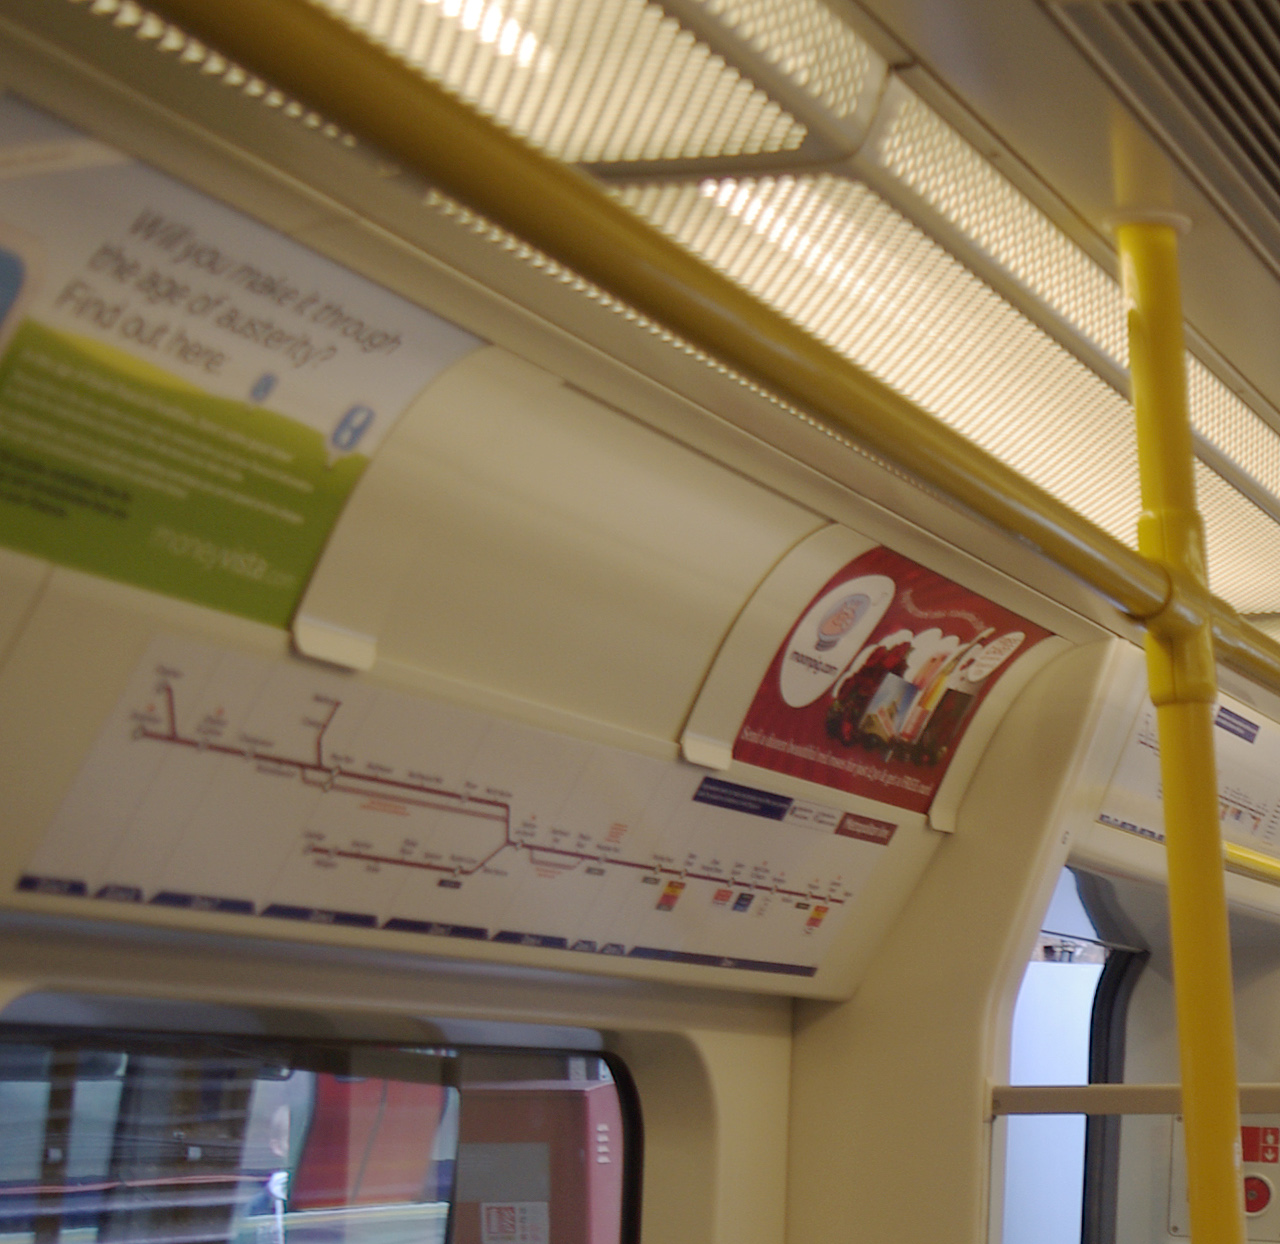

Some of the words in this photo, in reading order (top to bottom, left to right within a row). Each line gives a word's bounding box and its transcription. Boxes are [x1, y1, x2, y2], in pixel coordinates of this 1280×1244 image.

[55, 277, 124, 330] Find
[120, 312, 169, 350] out
[87, 244, 142, 284] the
[134, 266, 192, 306] age
[186, 293, 230, 317] of
[215, 304, 338, 369] austerity?
[129, 207, 195, 250] Will
[172, 240, 224, 276] you
[226, 263, 300, 307] make
[310, 299, 402, 354] through
